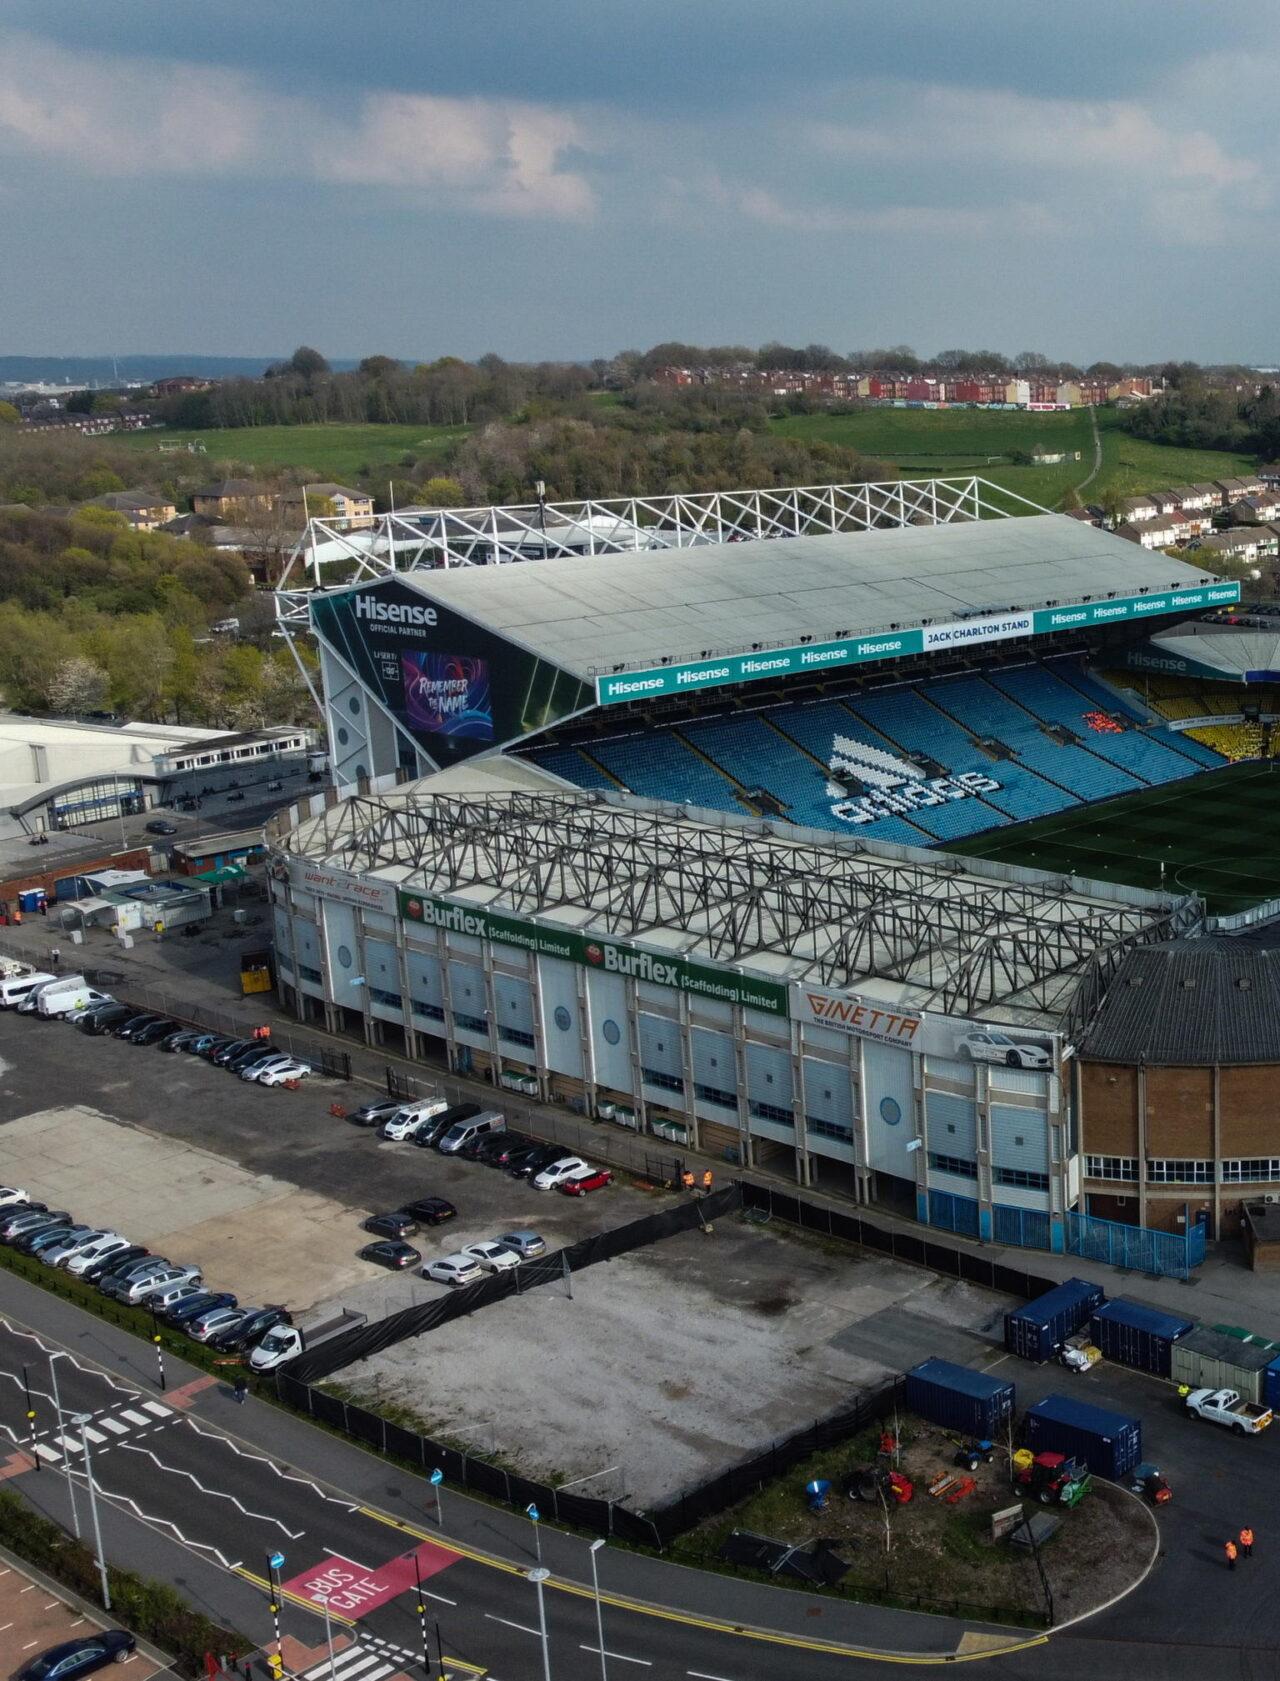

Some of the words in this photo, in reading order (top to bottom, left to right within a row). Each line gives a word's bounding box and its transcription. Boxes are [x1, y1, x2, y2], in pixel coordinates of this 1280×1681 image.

[1171, 592, 1203, 606] Hisense
[1207, 587, 1238, 601] Hisense
[355, 594, 438, 626] Hisense
[1093, 604, 1128, 619] Hisense
[1133, 599, 1166, 613] Hisense
[1051, 611, 1087, 626] Hisense
[370, 623, 398, 635] OFFICIAL
[398, 626, 427, 638] PARTNER
[928, 630, 952, 645] JACK
[953, 622, 1000, 640] CHARLTON
[1001, 618, 1030, 633] STAND
[801, 647, 848, 664] Hisense
[857, 639, 902, 656] Hisense
[740, 656, 791, 674] Hisense
[1127, 650, 1187, 672] Hisense
[676, 665, 730, 685] Hisense
[419, 677, 469, 694] REMEMBER
[608, 676, 664, 696] Hisense
[438, 694, 469, 713] NAME
[423, 899, 487, 938] Burflex
[487, 926, 538, 950] (Scaffolding)
[538, 939, 571, 957] Limited
[603, 944, 678, 986] Burflex
[680, 974, 740, 1002] (Scaffolding)
[741, 990, 778, 1010] Limited
[806, 993, 922, 1038] GINETTA
[304, 1568, 355, 1595] BUS
[329, 1576, 390, 1610] GATE
